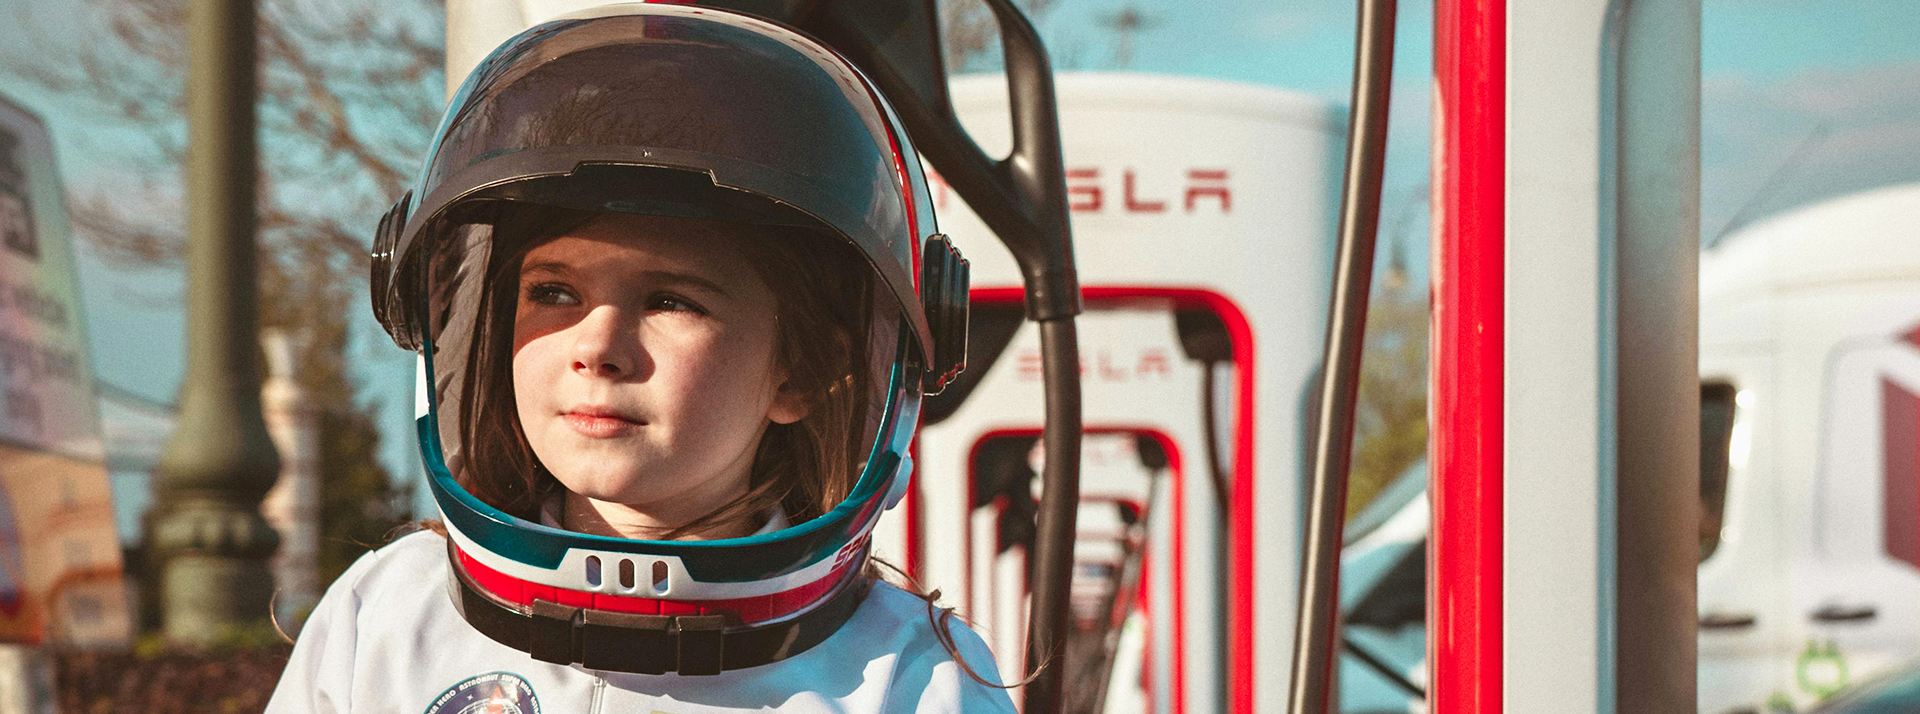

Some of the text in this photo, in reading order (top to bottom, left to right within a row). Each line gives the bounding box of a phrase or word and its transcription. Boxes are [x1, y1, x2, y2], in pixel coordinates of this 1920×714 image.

[438, 689, 456, 706] HERO
[459, 674, 499, 691] ASTRONAUT
[501, 674, 520, 685] SUPER
[520, 681, 532, 696] HERO
